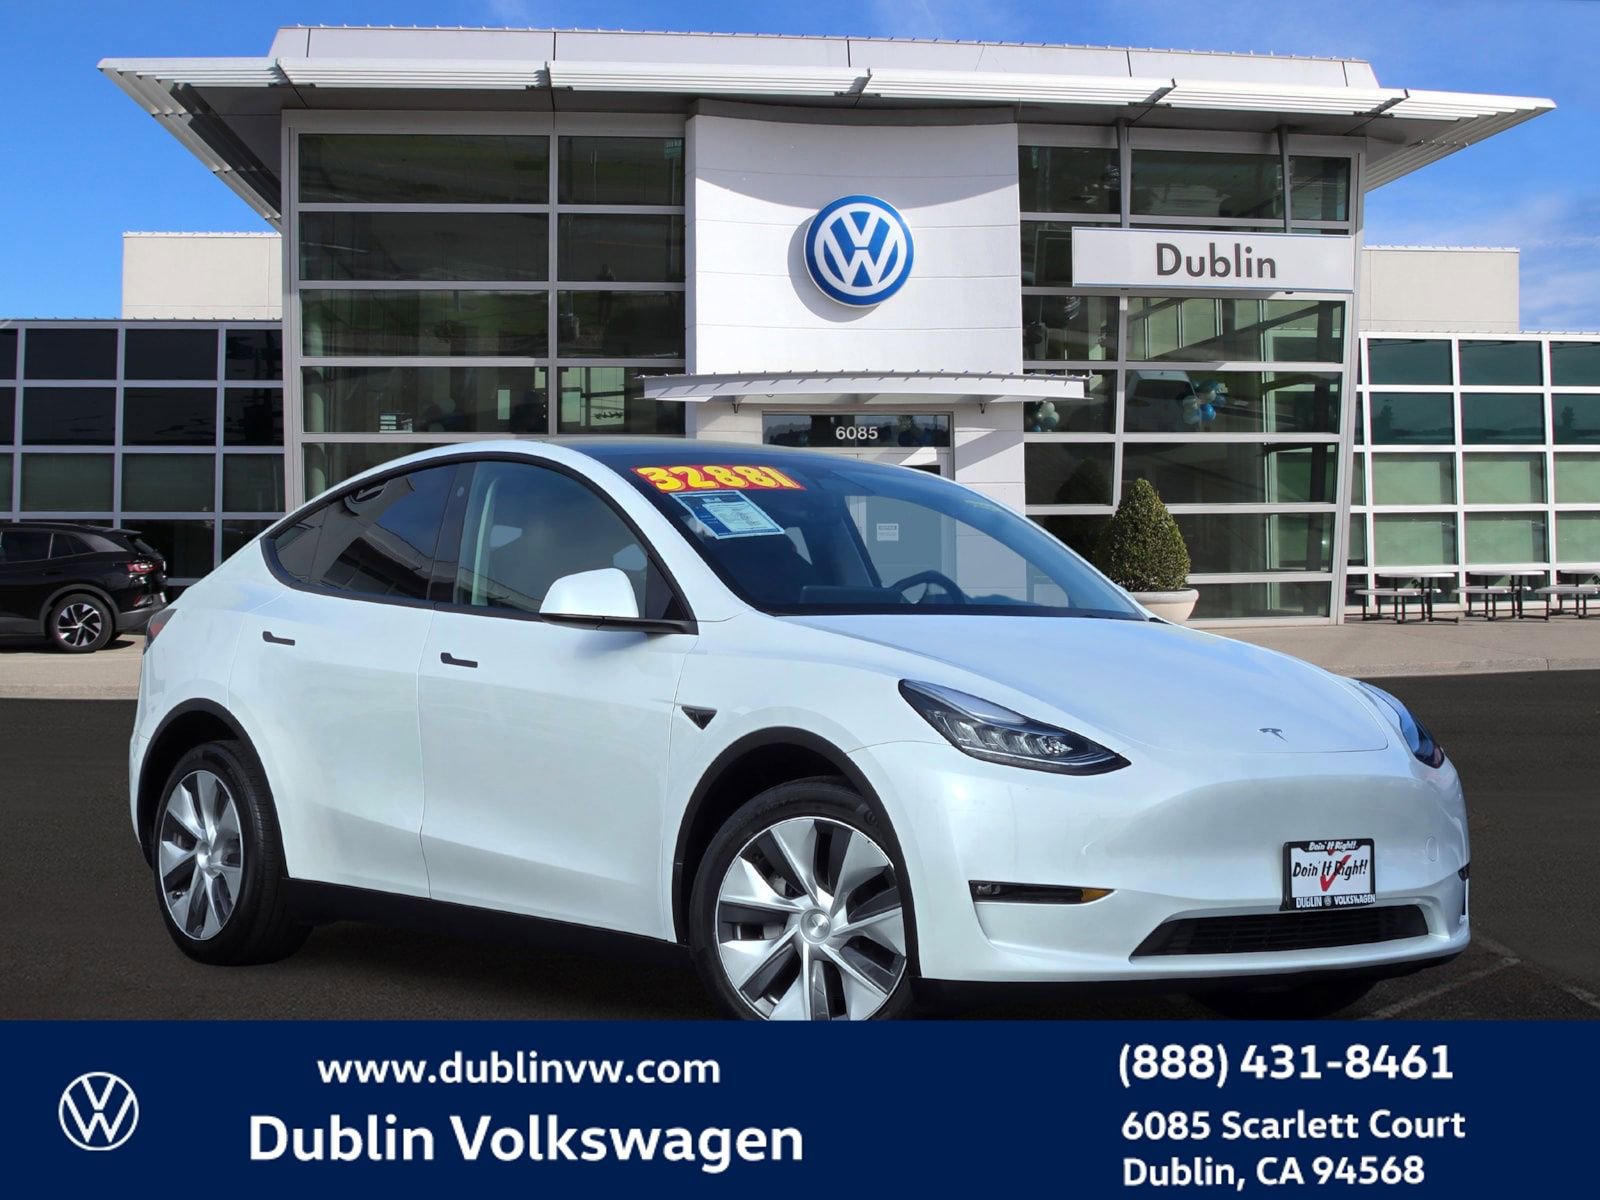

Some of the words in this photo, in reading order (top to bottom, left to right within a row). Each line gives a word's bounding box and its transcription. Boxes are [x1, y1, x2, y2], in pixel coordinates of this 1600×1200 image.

[1157, 243, 1276, 279] Dublin
[835, 426, 879, 441] 6085
[637, 466, 801, 491] 32881
[1335, 841, 1357, 852] Right!
[1292, 861, 1321, 878] Doin'
[1322, 860, 1333, 876] It
[1335, 859, 1369, 881] Right!
[1296, 896, 1322, 909] DUBLIN
[1334, 894, 1376, 906] VOLKSWAGEN
